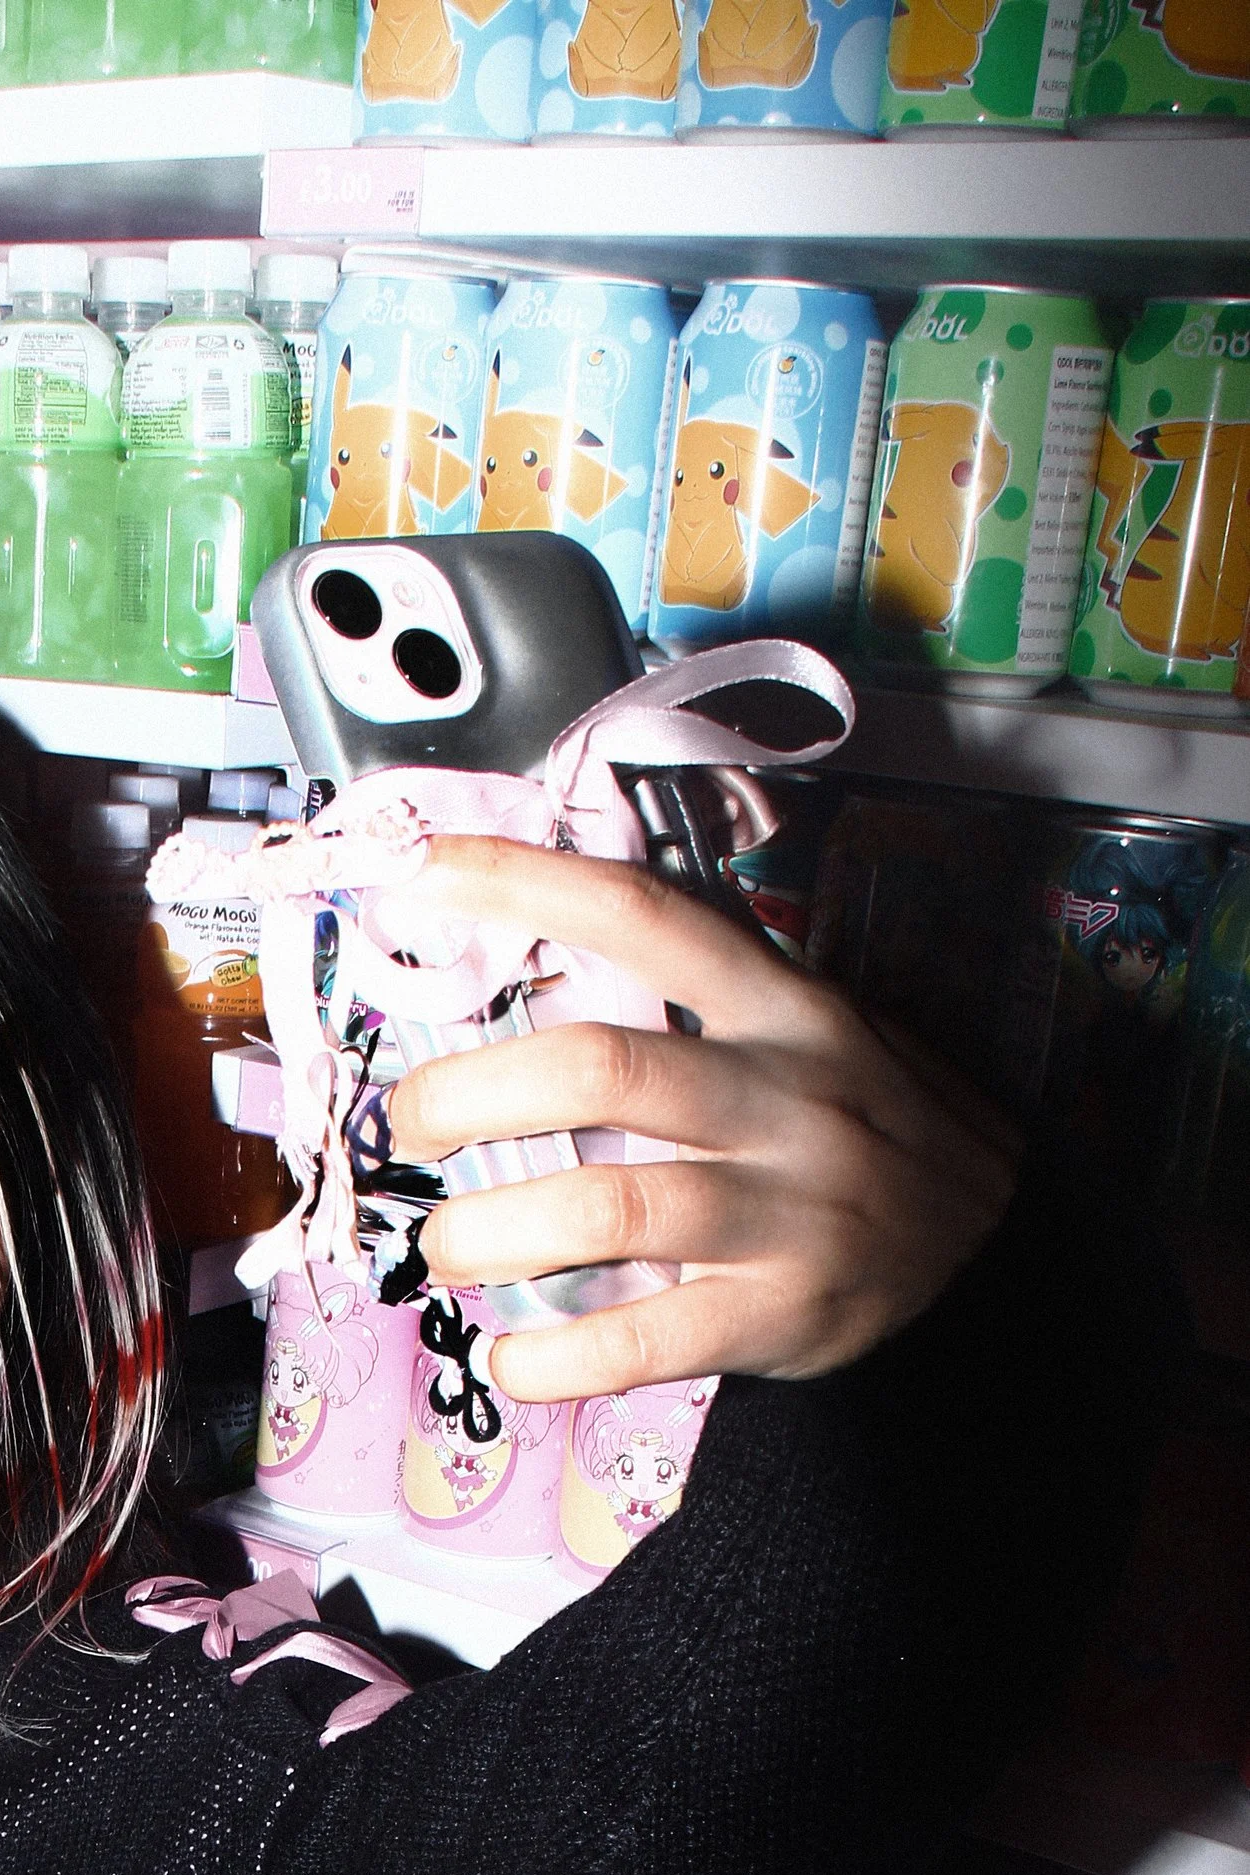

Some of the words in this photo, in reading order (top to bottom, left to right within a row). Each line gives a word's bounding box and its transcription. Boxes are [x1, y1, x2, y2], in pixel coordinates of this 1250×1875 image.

[1173, 311, 1250, 358] QDO
[283, 341, 316, 358] MOG
[168, 902, 209, 919] MOGU
[213, 904, 257, 923] MOGU
[456, 1289, 483, 1301] flavour
